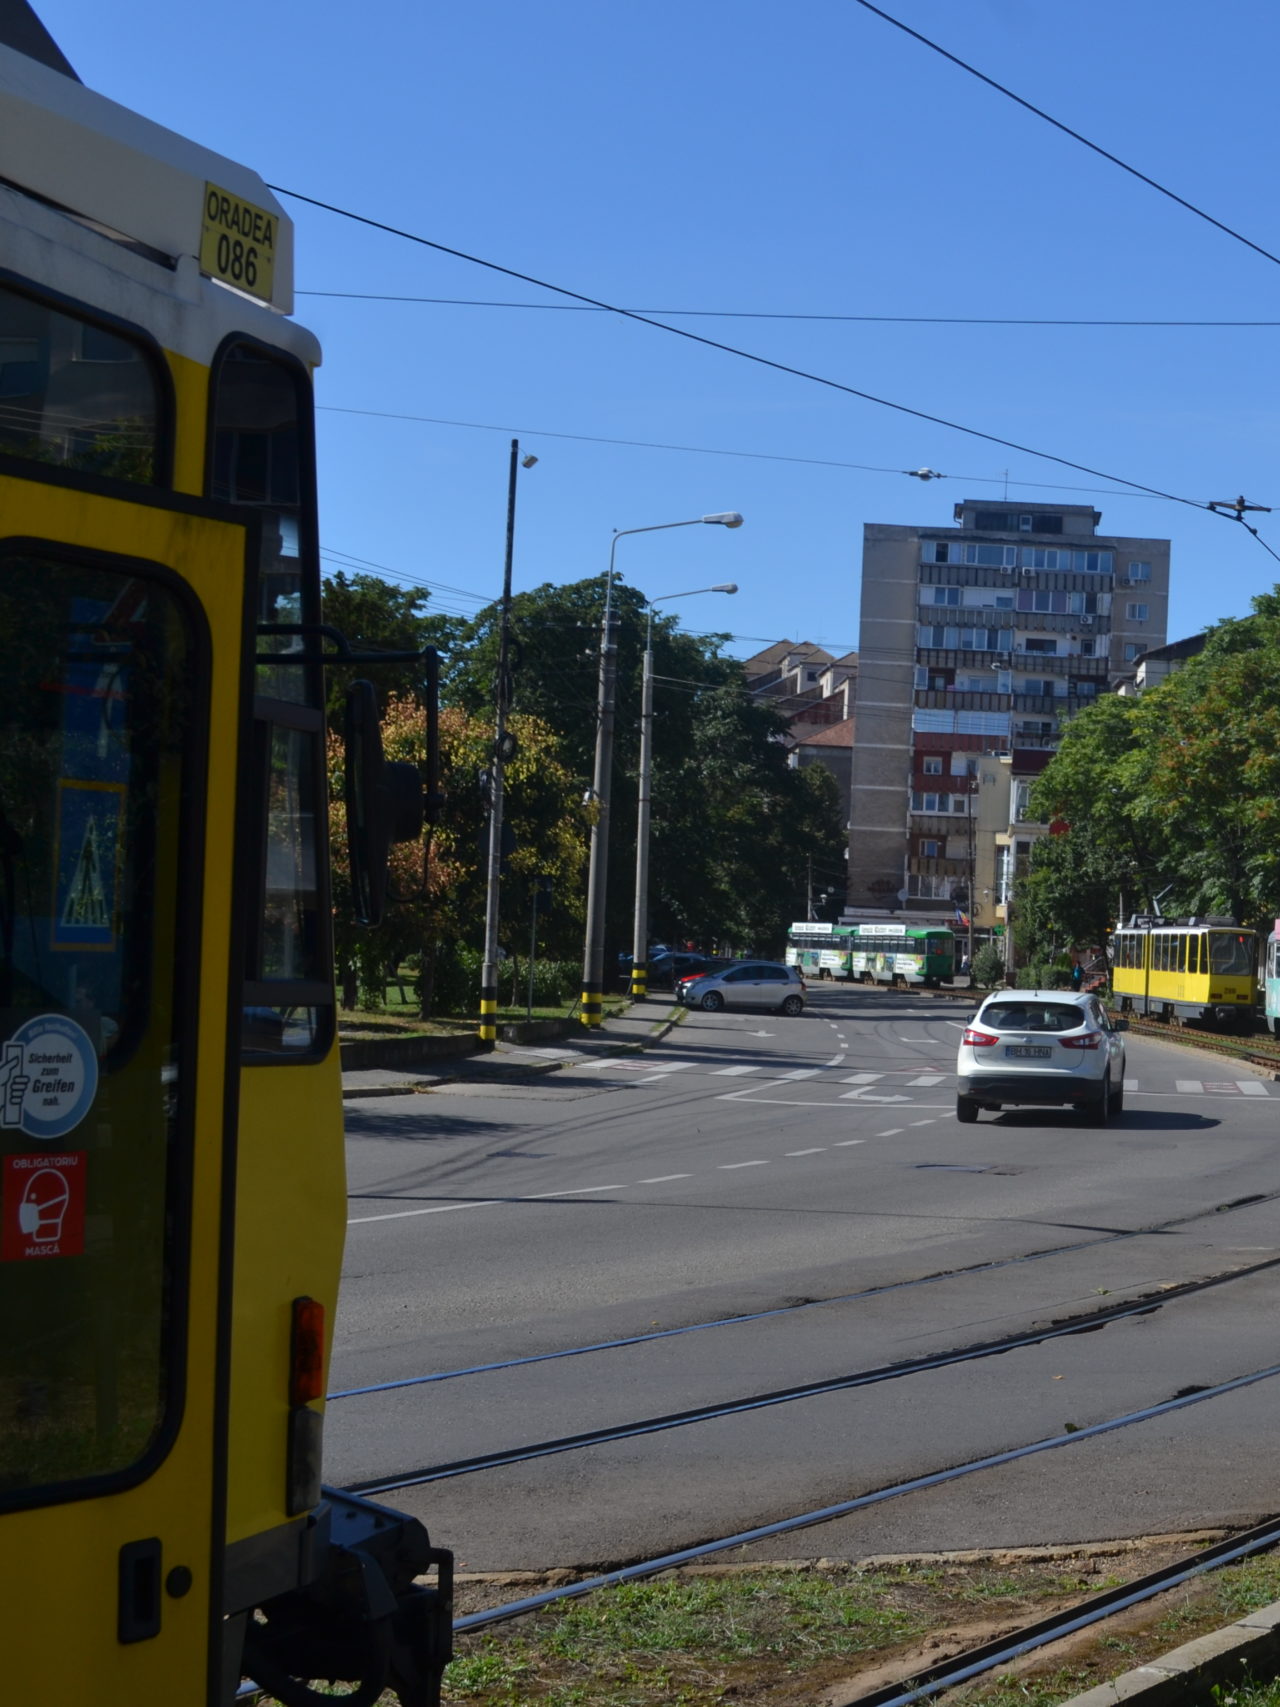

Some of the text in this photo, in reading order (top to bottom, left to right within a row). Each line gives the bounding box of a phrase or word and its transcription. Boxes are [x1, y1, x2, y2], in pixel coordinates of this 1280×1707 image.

[207, 191, 273, 249] ORADEA
[217, 233, 258, 287] 086
[28, 1052, 73, 1064] Sicherheit
[41, 1067, 59, 1076] zum
[32, 1079, 75, 1093] Greifen
[42, 1096, 60, 1107] nah.
[12, 1156, 78, 1169] OBLIGATORIU
